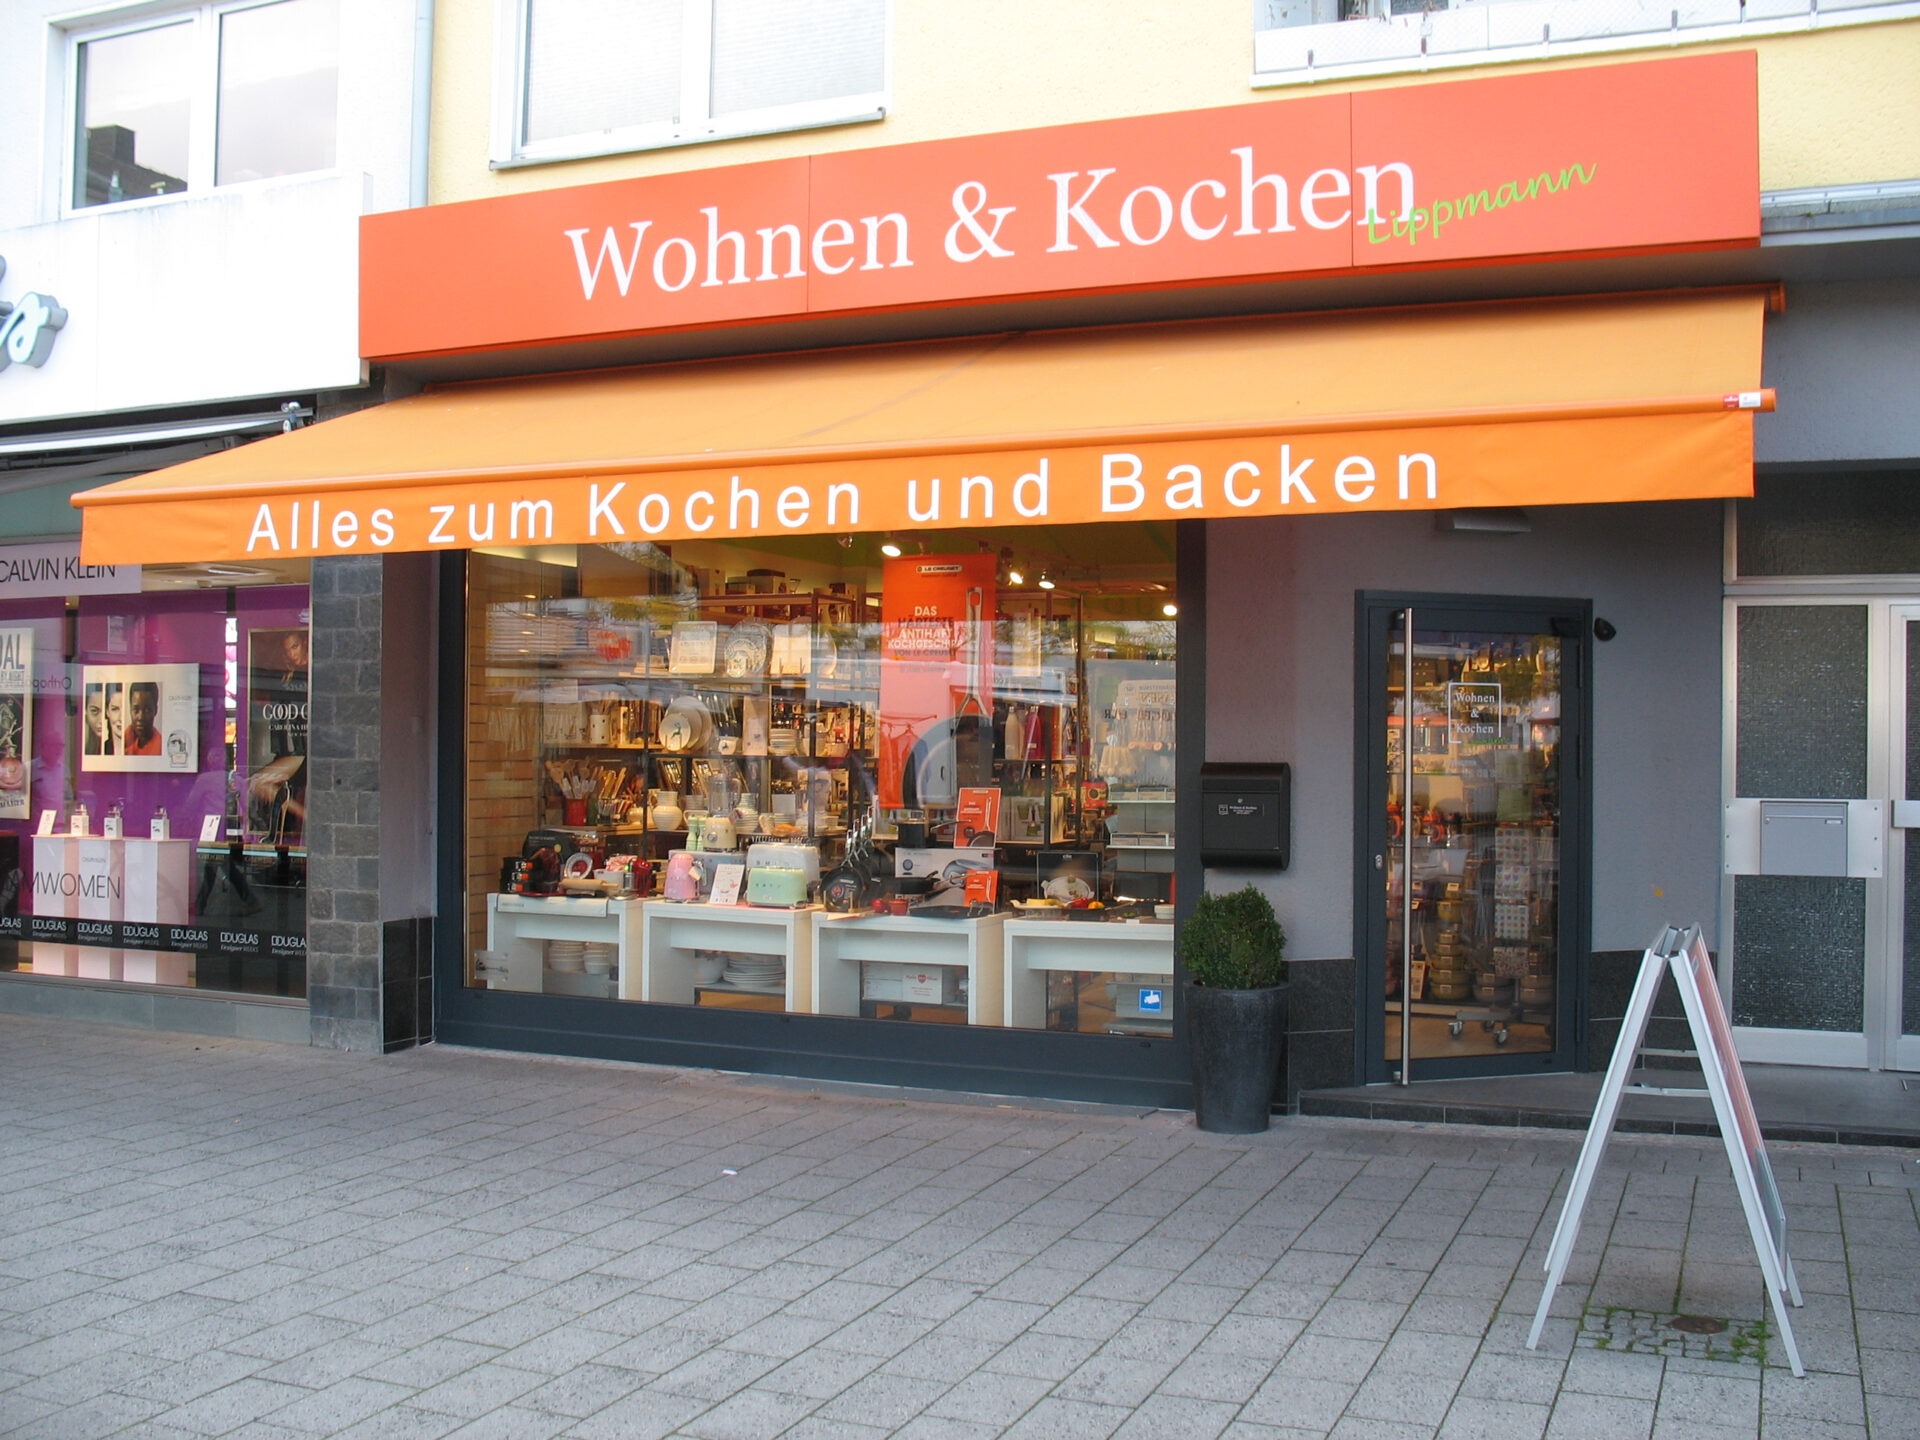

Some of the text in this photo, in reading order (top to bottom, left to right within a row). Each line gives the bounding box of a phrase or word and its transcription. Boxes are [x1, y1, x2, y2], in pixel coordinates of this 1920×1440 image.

[1368, 162, 1597, 246] Lippmann
[565, 147, 1422, 300] Wohnen & Kochen
[247, 444, 1437, 552] Alles zum Kochen und Backen
[0, 558, 59, 583] CALVIN
[914, 606, 937, 616] DAS
[1456, 692, 1495, 703] Wohnen
[263, 703, 298, 720] GOOD
[1470, 707, 1479, 718] &
[1456, 723, 1494, 733] Kochen
[32, 919, 67, 931] DOUGLAS
[77, 922, 113, 935] DOUGLAS
[122, 926, 160, 938] DOUGLAS
[170, 928, 209, 942] DOUGLAS
[220, 931, 259, 945] DOUGLAS
